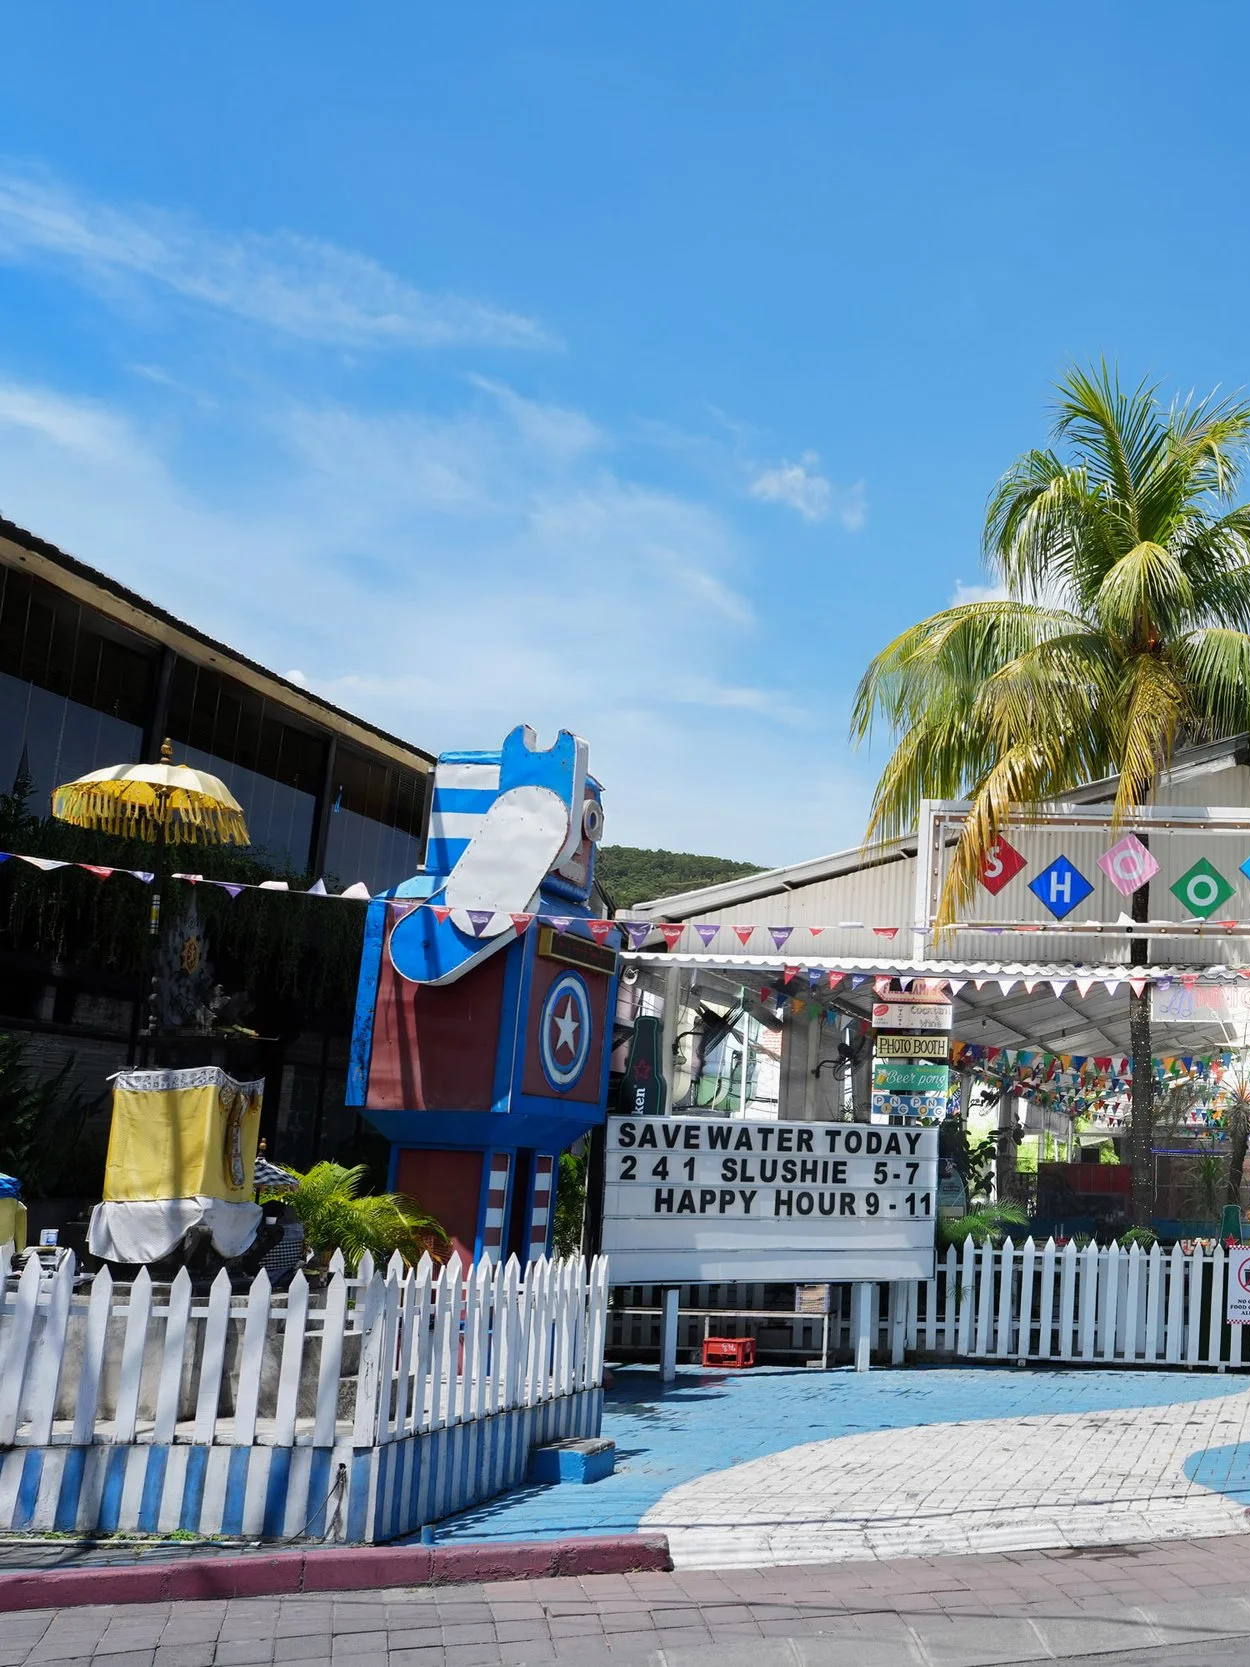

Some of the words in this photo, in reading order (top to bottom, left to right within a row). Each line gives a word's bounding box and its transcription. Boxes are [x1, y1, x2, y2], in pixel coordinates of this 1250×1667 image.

[879, 1037, 911, 1054] PHOTO
[913, 1040, 945, 1055] BOOTH
[886, 1070, 915, 1085] Beer
[918, 1074, 946, 1088] pong
[618, 1122, 701, 1149] SAVE
[707, 1125, 814, 1152] WATER
[825, 1129, 922, 1155] TODAY
[721, 1158, 848, 1185] SLUSHIE
[654, 1188, 758, 1214] HAPPY
[774, 1190, 856, 1216] HOUR
